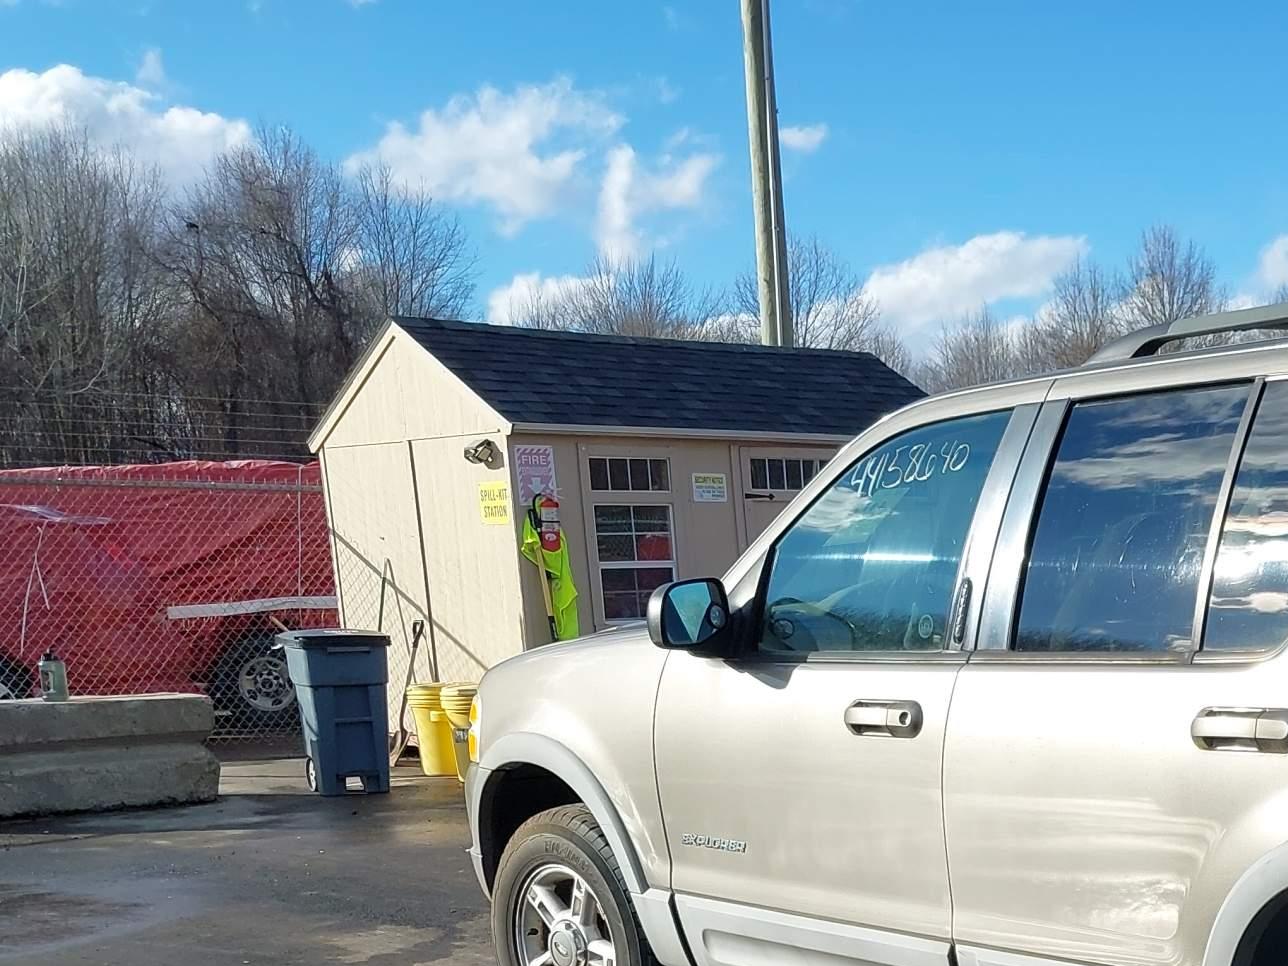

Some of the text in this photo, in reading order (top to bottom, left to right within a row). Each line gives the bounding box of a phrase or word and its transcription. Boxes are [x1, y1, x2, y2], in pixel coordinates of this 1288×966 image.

[521, 455, 547, 465] FIRE
[850, 439, 970, 498] 44158640
[480, 488, 507, 502] SPILL-KIT
[483, 505, 508, 518] STATION
[682, 833, 747, 853] EXPLORER
